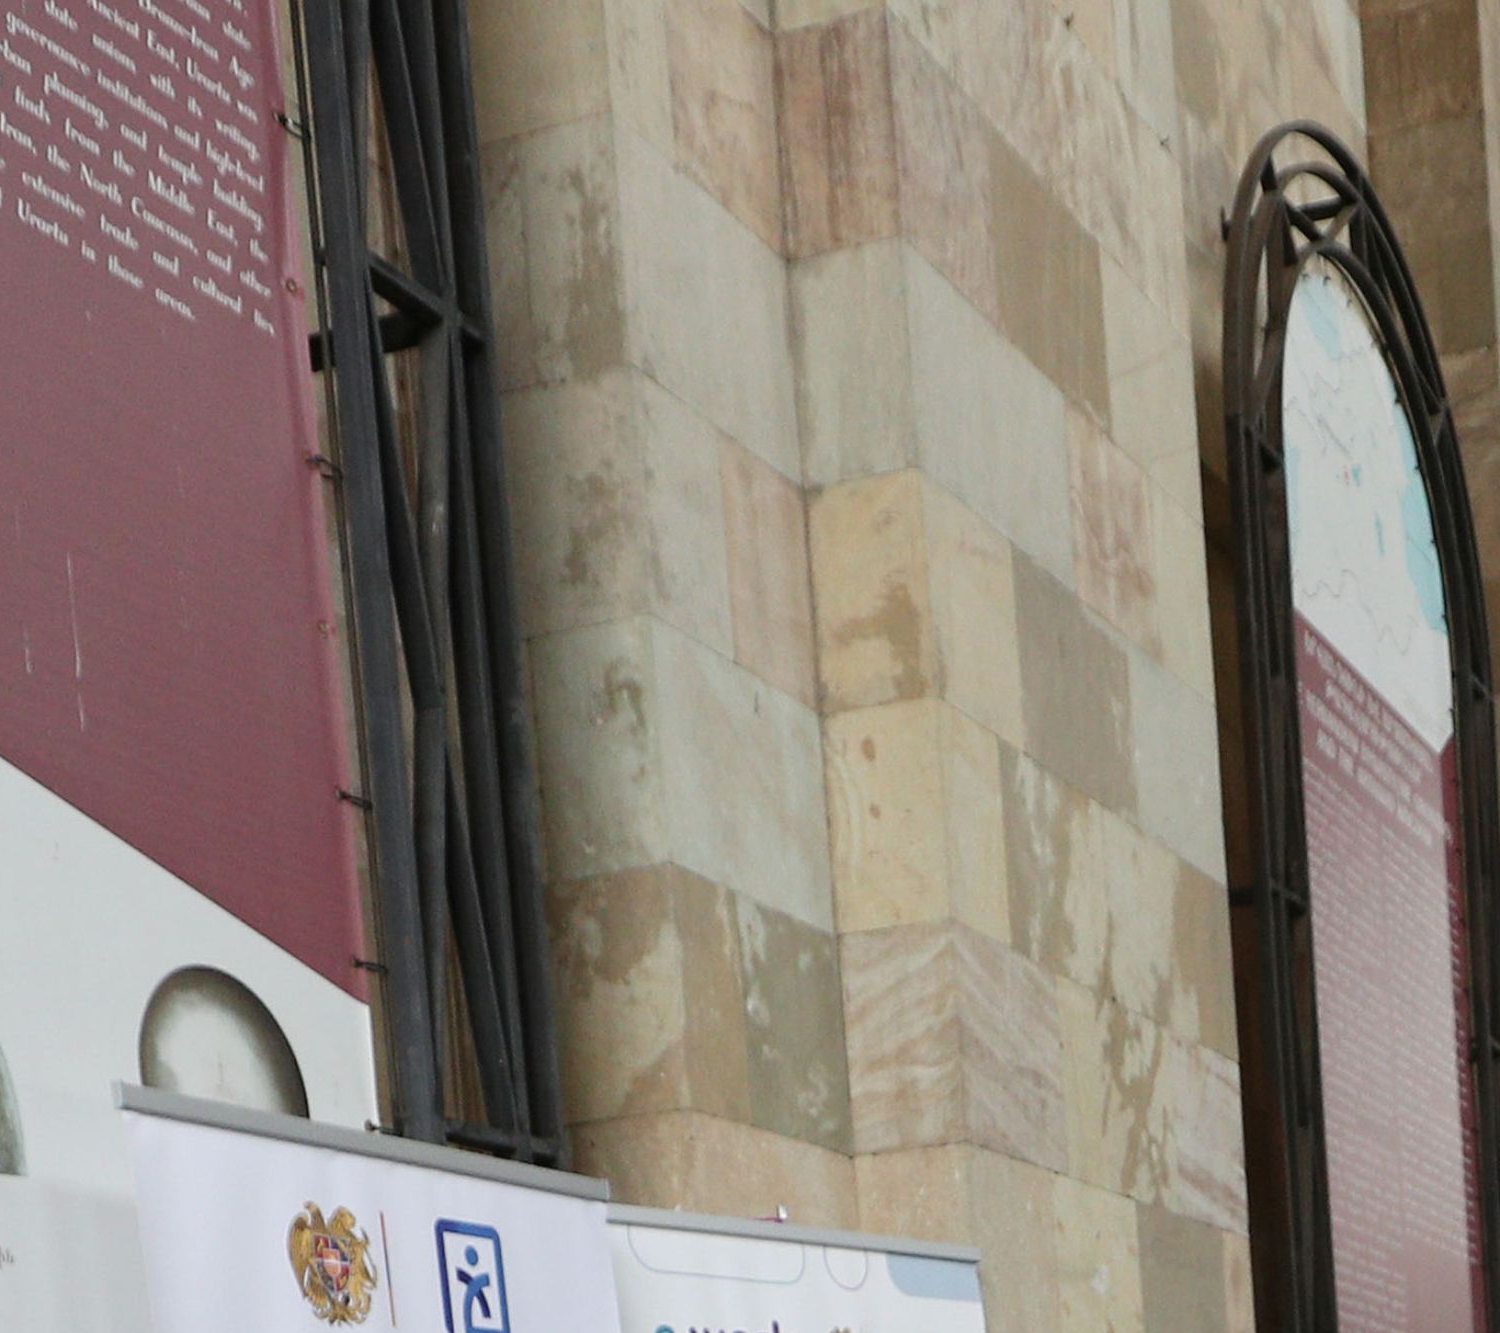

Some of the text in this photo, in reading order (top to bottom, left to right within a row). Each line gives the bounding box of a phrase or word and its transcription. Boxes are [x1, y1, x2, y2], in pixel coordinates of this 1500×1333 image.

[44, 72, 108, 130] planning,
[121, 124, 147, 151] and
[158, 144, 203, 186] temple
[150, 74, 175, 99] with
[187, 57, 231, 104] Urartu
[0, 111, 37, 156] Iran,
[47, 145, 71, 173] the
[80, 162, 123, 206] North
[132, 196, 199, 256] Caucasus,
[206, 249, 231, 275] and
[240, 269, 271, 297] other
[15, 85, 51, 125] finds
[65, 118, 100, 155] from
[113, 150, 135, 176] the
[149, 169, 196, 216] Middle
[250, 237, 269, 263] the
[174, 125, 199, 151] and
[206, 139, 264, 193] high-level
[17, 198, 69, 245] Urartu
[81, 240, 96, 262] in
[108, 253, 145, 289] those
[22, 171, 85, 218] extensive
[100, 213, 139, 250] trade
[153, 251, 179, 277] and
[193, 275, 242, 314] cultural
